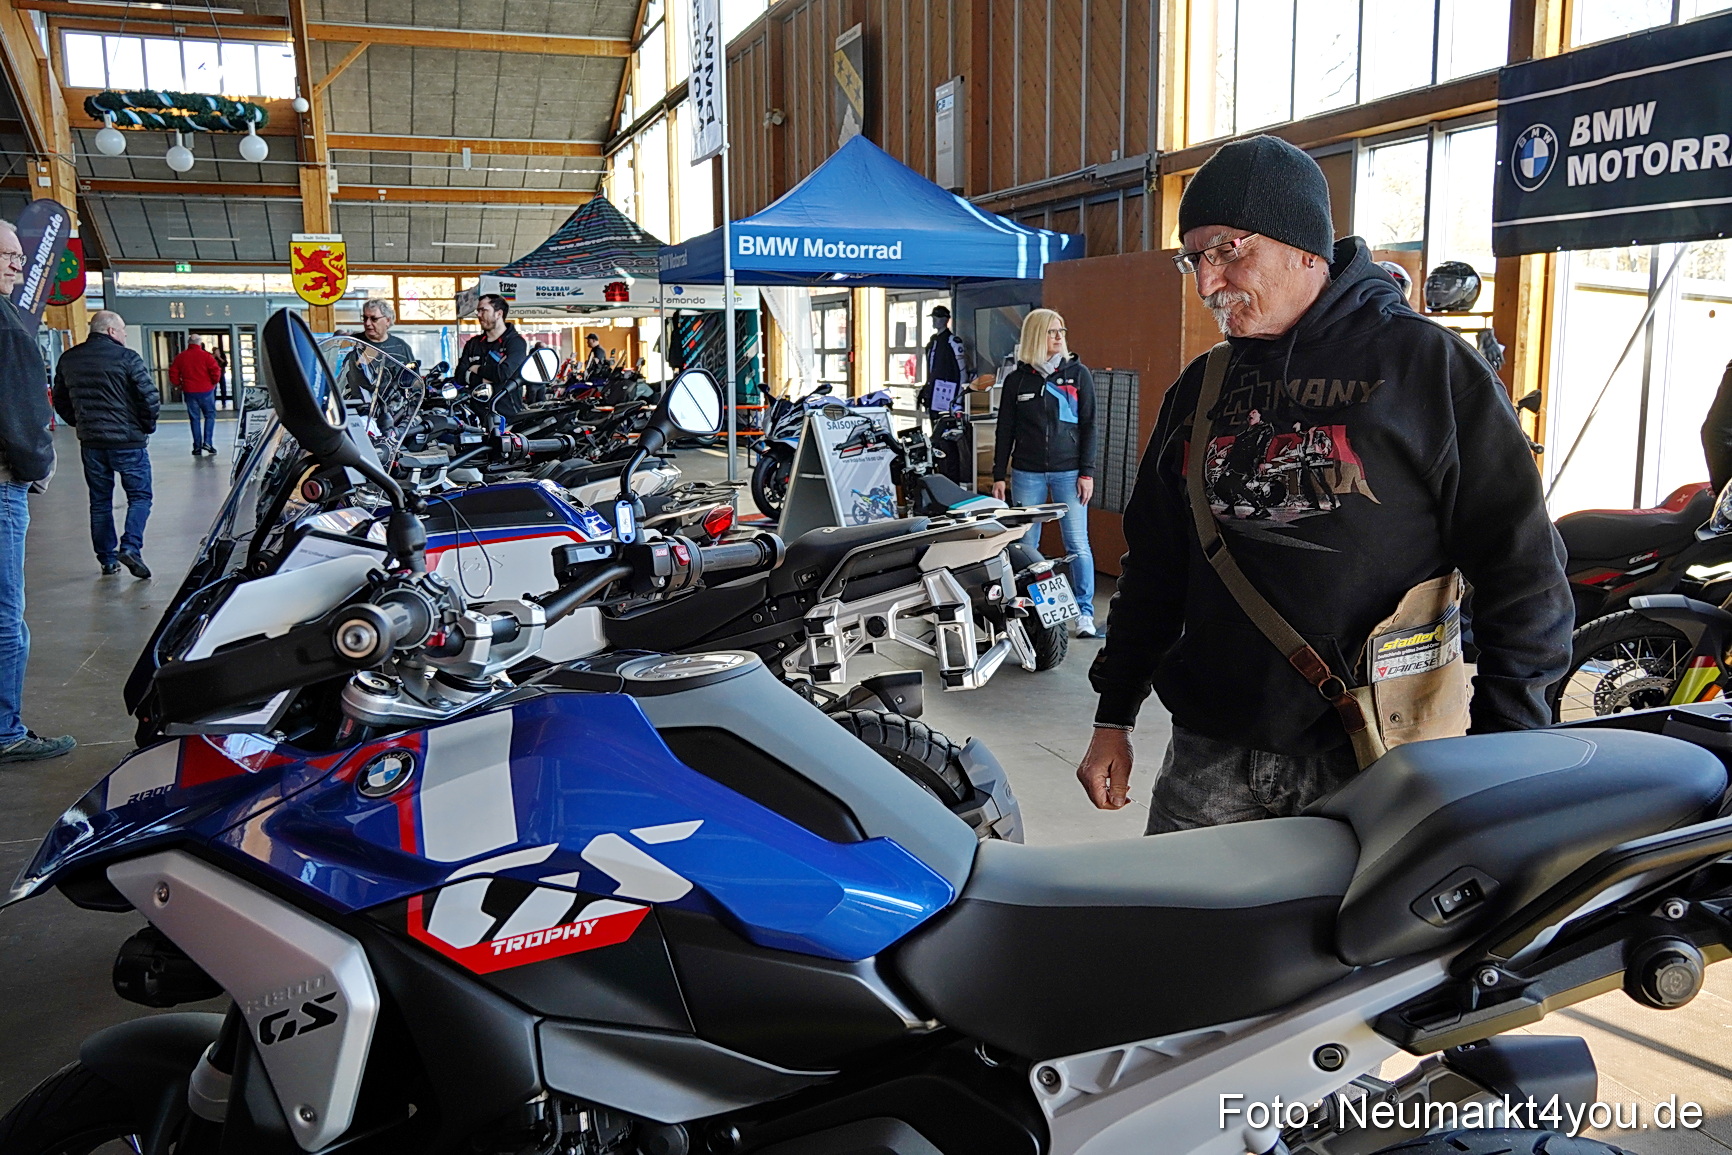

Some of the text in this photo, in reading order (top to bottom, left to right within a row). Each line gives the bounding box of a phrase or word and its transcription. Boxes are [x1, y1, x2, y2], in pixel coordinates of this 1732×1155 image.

[1569, 101, 1657, 147] BMW
[1518, 127, 1553, 149] BMW
[1567, 134, 1732, 187] MOTORR
[739, 235, 902, 260] BMW Motorrad
[19, 213, 63, 310] TRAILER-DIRECT.de
[827, 418, 881, 431] SAISONSRT
[1040, 577, 1065, 595] PAR
[1378, 632, 1437, 653] stadler
[1388, 658, 1437, 675] DAINESE
[491, 919, 599, 956] TROPHY
[257, 991, 338, 1046] GS
